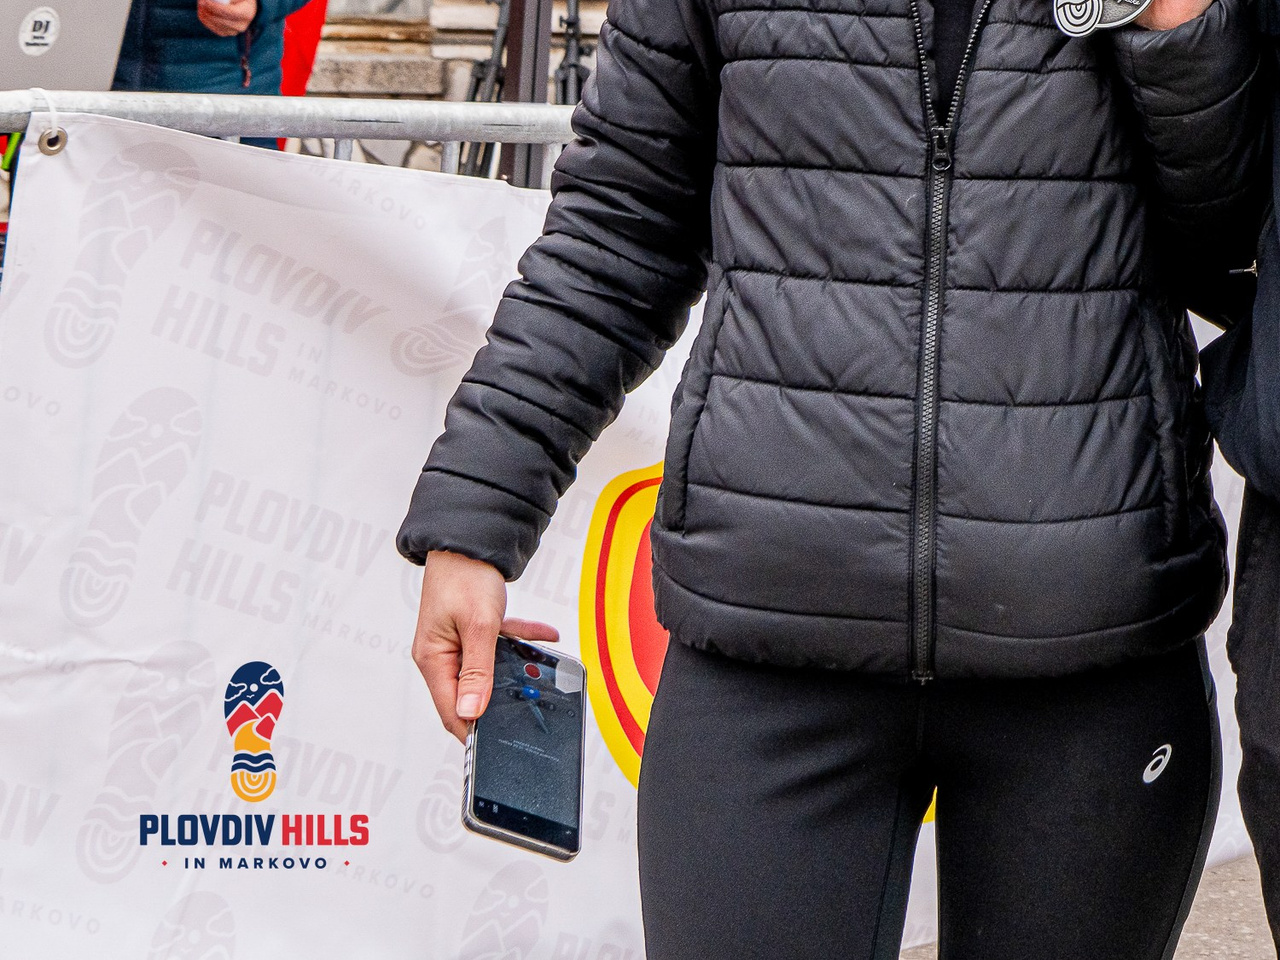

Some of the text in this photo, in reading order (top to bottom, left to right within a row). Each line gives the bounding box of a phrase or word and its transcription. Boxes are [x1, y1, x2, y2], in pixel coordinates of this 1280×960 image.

[180, 218, 391, 334] PLOVDIV
[150, 284, 286, 378] HILLS
[287, 366, 403, 421] MARKOVO
[195, 469, 392, 578] PLOVDIV
[165, 538, 301, 625] HILLS
